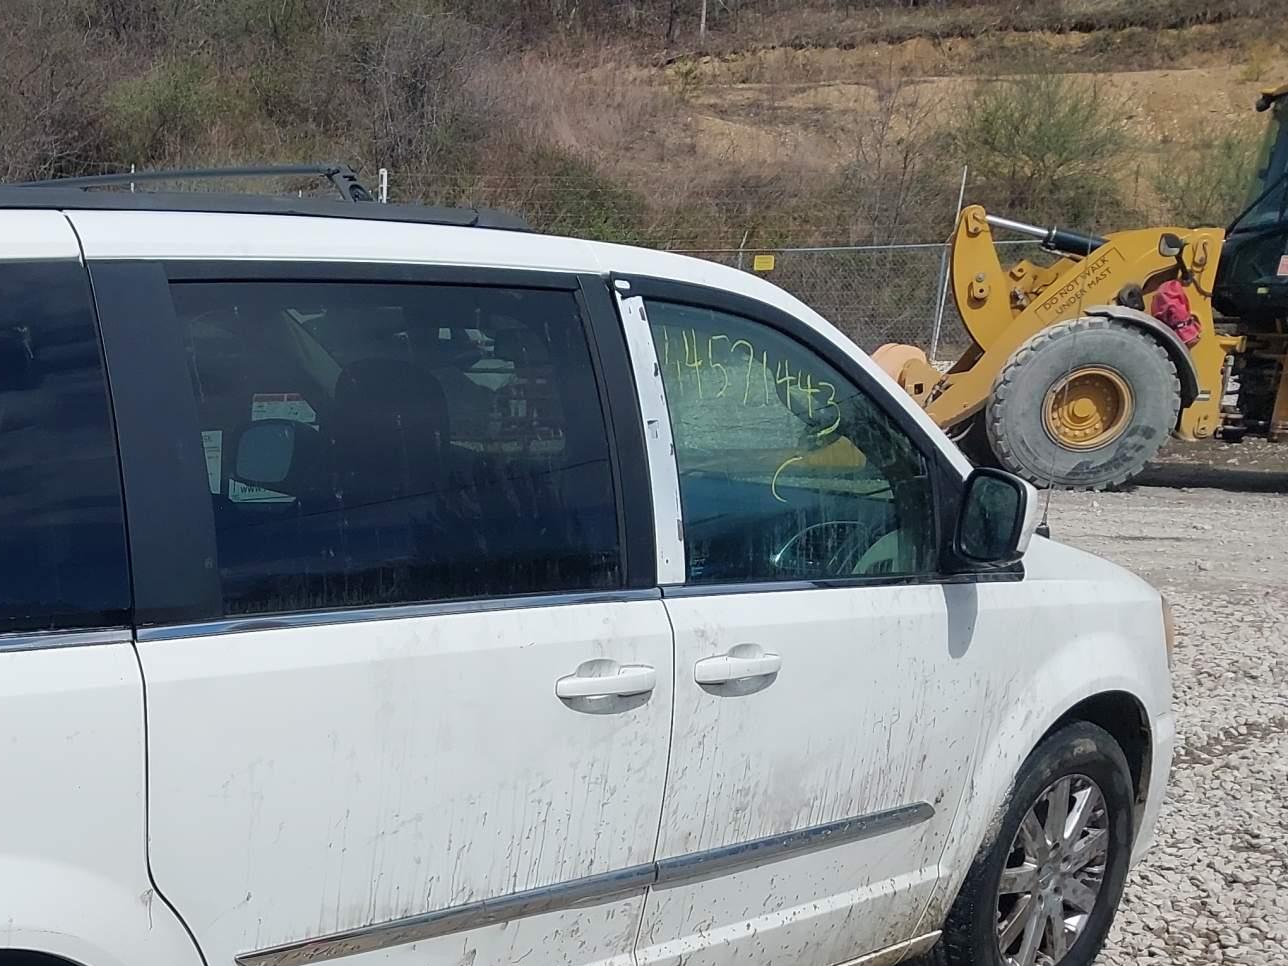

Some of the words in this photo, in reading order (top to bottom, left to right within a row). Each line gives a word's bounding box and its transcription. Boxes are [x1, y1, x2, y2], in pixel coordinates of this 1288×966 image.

[1043, 296, 1059, 311] DO
[1060, 278, 1079, 298] NOT
[1080, 255, 1109, 280] WALK
[1055, 287, 1087, 314] UNDER
[1087, 267, 1112, 290] MAST
